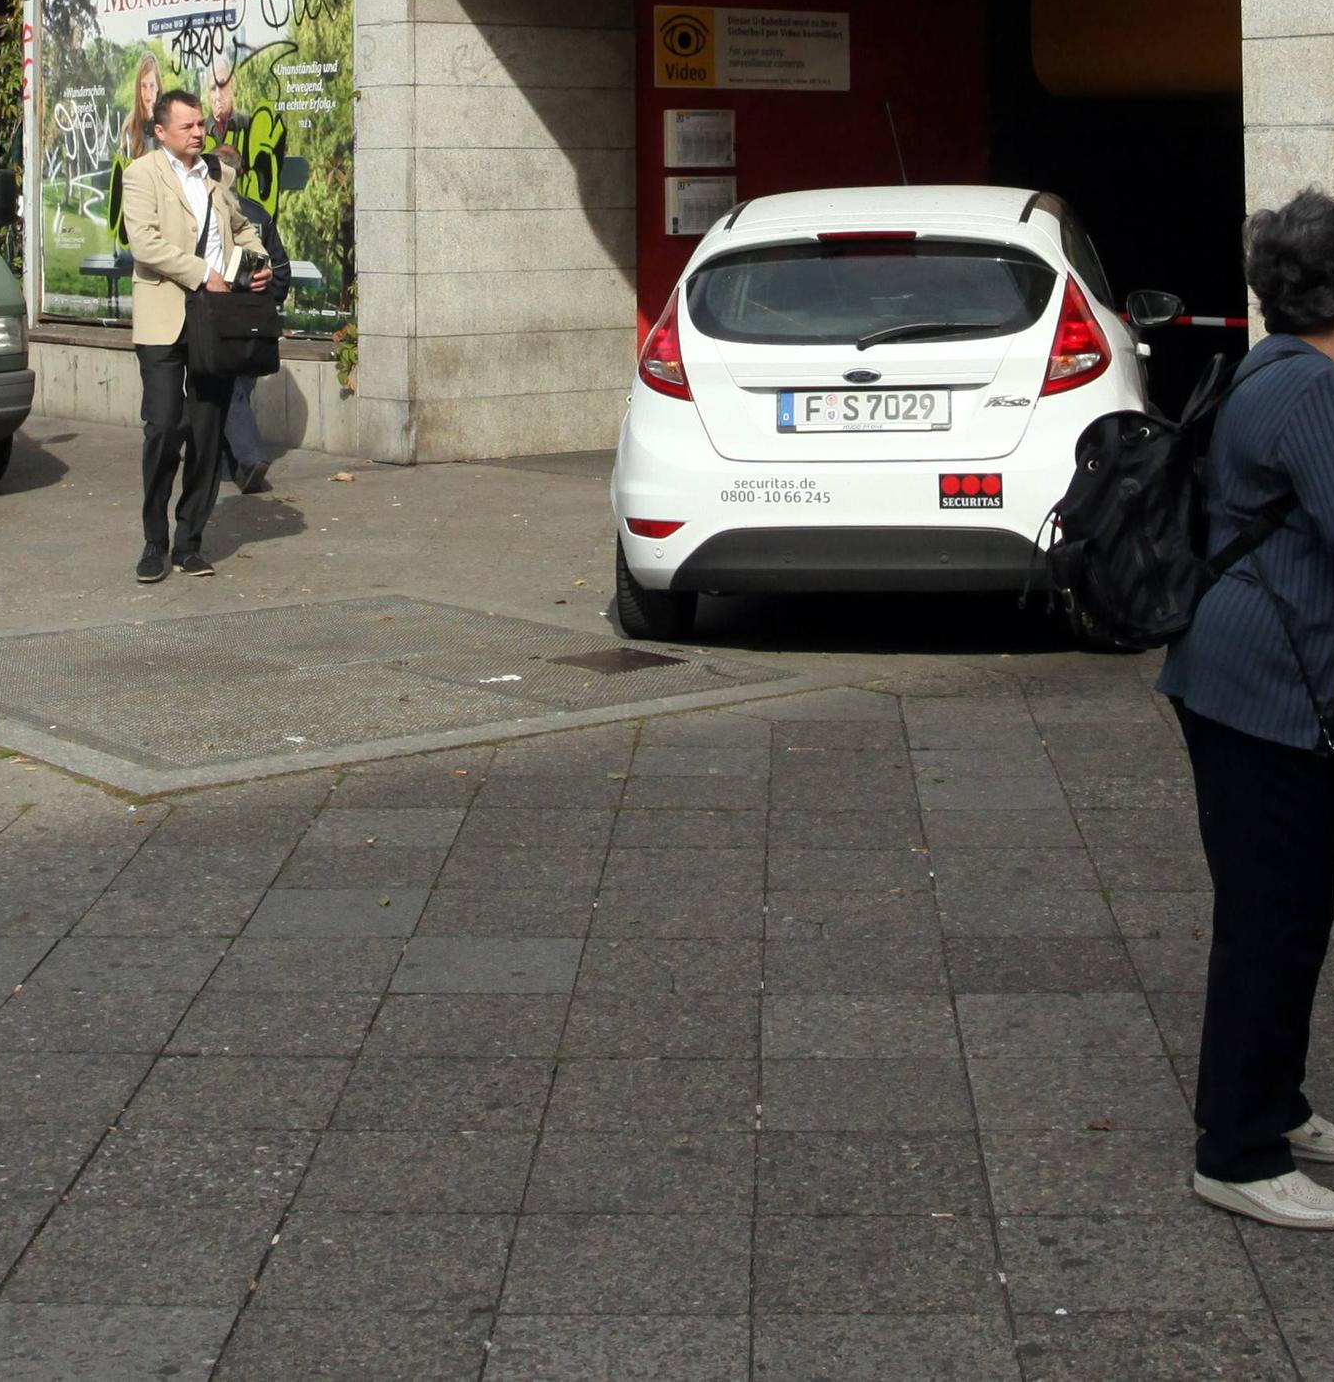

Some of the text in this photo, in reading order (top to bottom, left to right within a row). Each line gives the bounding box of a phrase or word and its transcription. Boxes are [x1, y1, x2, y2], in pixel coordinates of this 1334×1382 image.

[323, 60, 339, 73] und
[666, 63, 707, 81] Video
[806, 393, 935, 422] F S 7029
[734, 477, 816, 490] securitas.de
[942, 497, 1001, 507] SECURITAS
